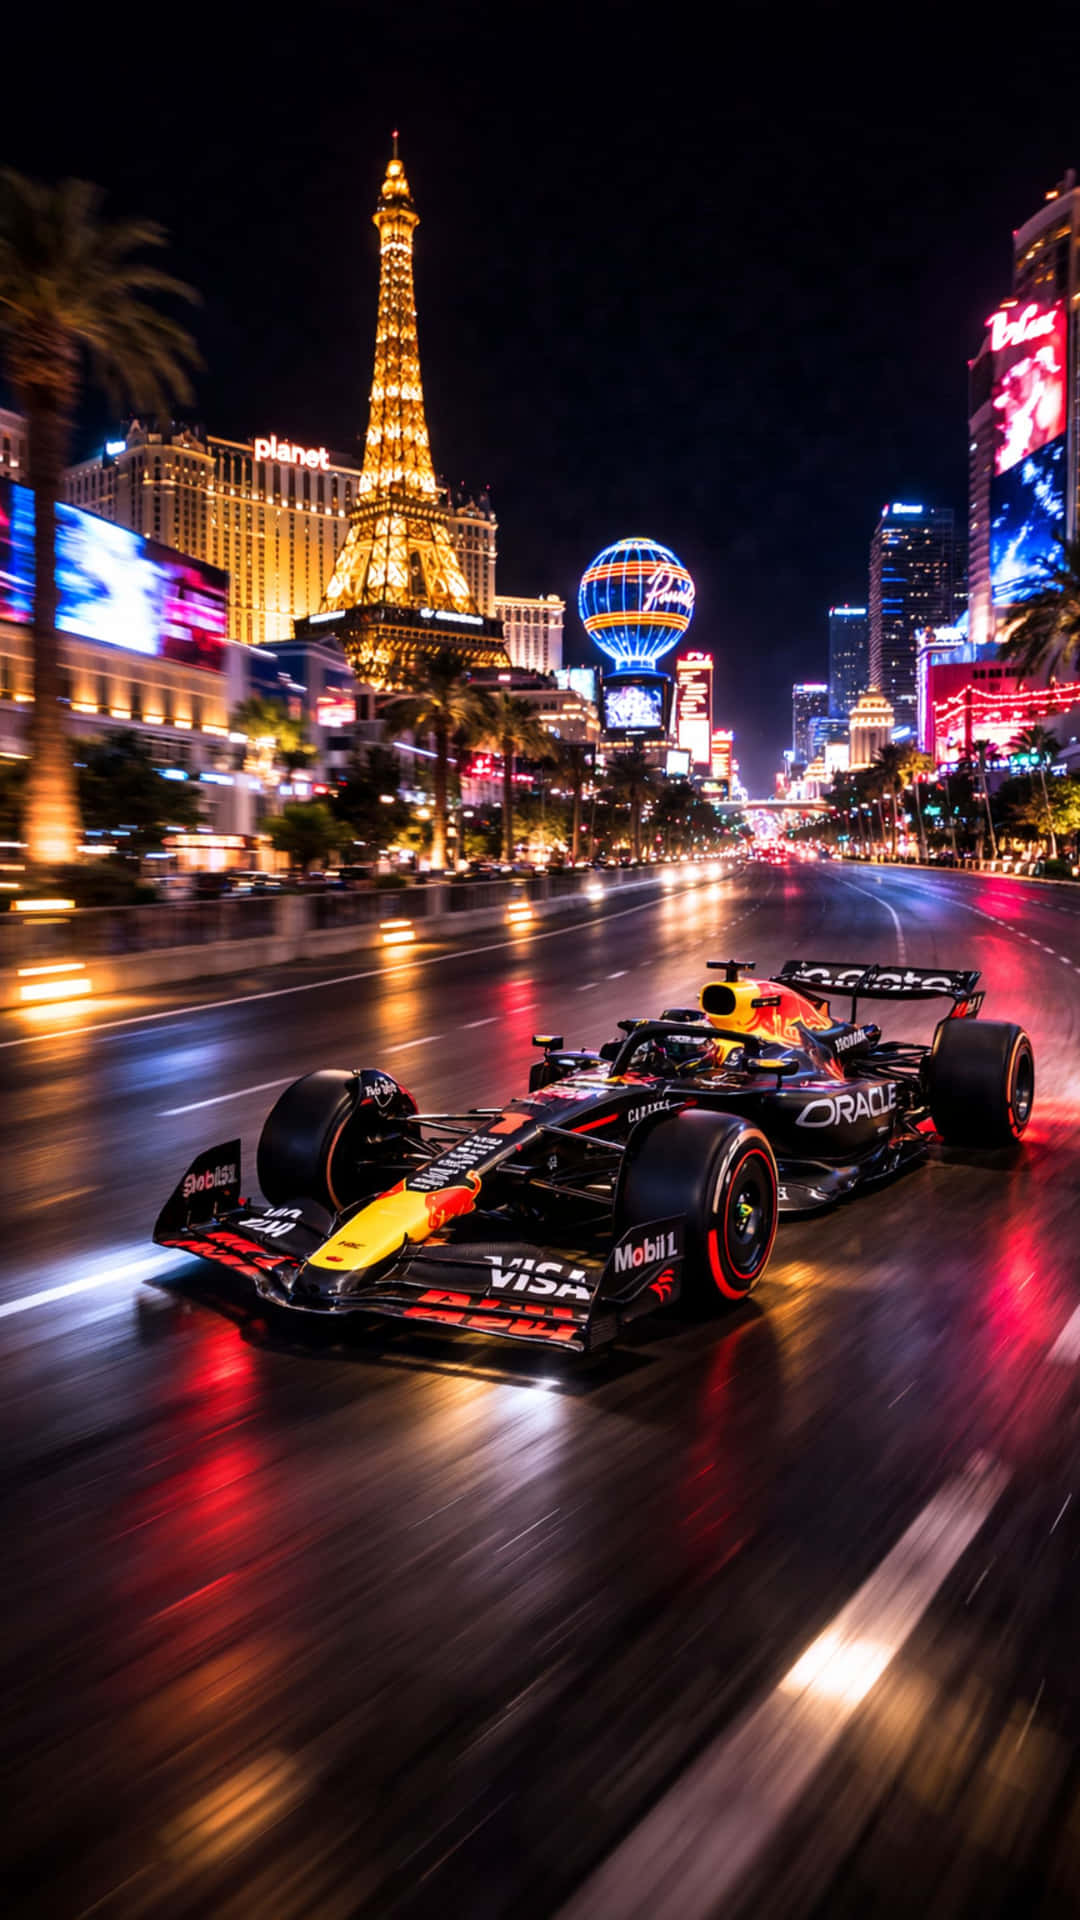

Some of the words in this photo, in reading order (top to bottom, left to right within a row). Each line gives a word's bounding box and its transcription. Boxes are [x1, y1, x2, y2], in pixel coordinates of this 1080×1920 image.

[254, 434, 330, 471] planet
[795, 1083, 897, 1128] ORACLE
[484, 1255, 591, 1300] VISA
